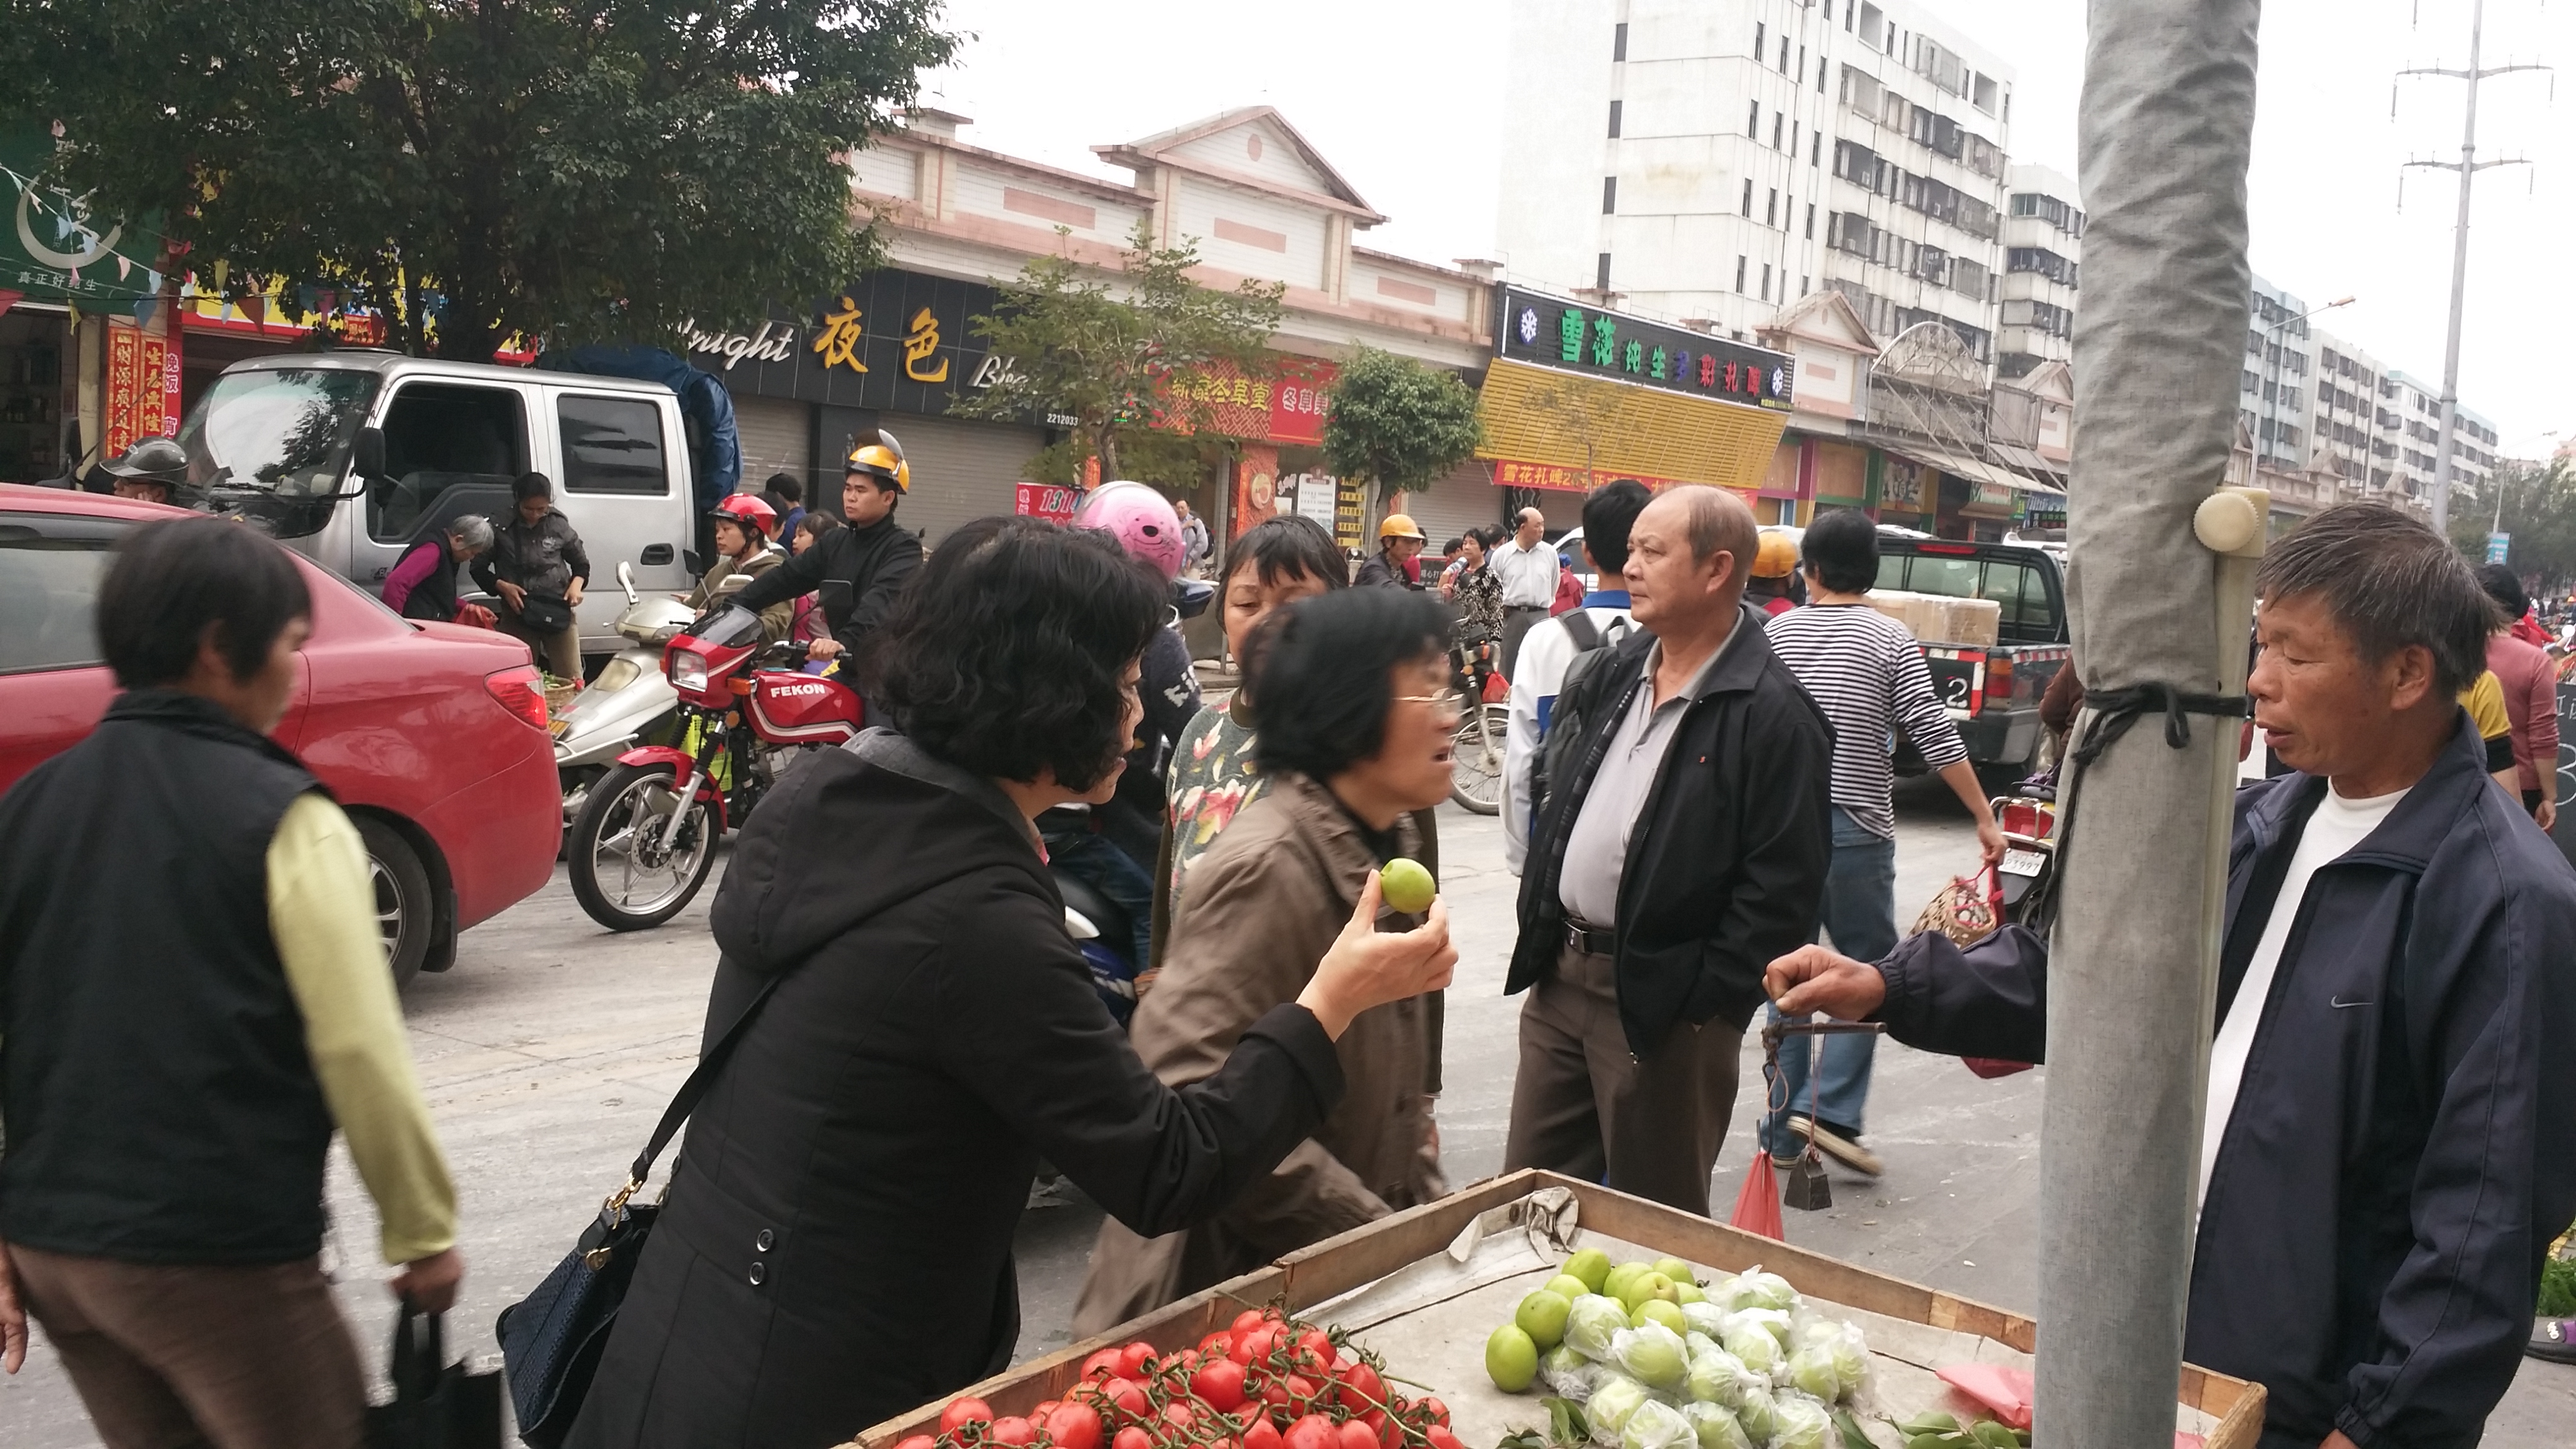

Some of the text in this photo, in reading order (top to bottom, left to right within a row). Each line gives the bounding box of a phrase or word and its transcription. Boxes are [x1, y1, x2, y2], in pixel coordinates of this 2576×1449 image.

[814, 295, 949, 382] 夜色
[163, 416, 178, 438] 宵
[770, 684, 825, 698] FEKON
[1946, 677, 1968, 708] 2
